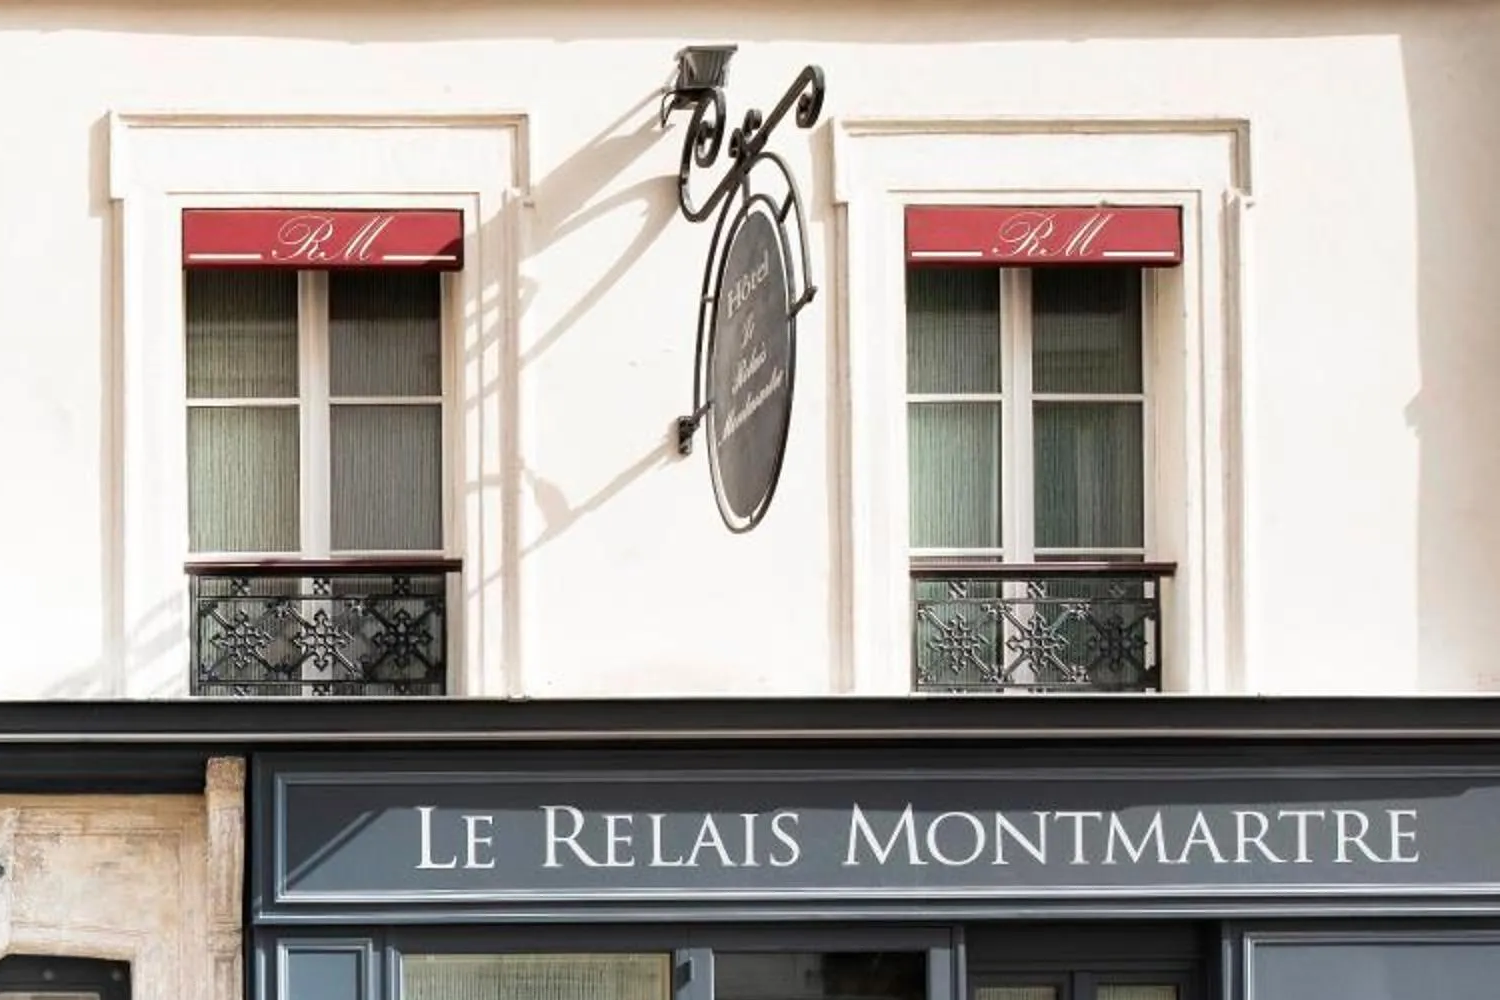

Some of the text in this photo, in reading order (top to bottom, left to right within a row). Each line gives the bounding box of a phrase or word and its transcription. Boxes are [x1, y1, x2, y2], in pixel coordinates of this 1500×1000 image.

[271, 214, 396, 262] RM
[991, 211, 1115, 257] RM
[727, 250, 769, 319] Hôtel
[415, 803, 1421, 870] LE RELAIS MONTMARTRE
